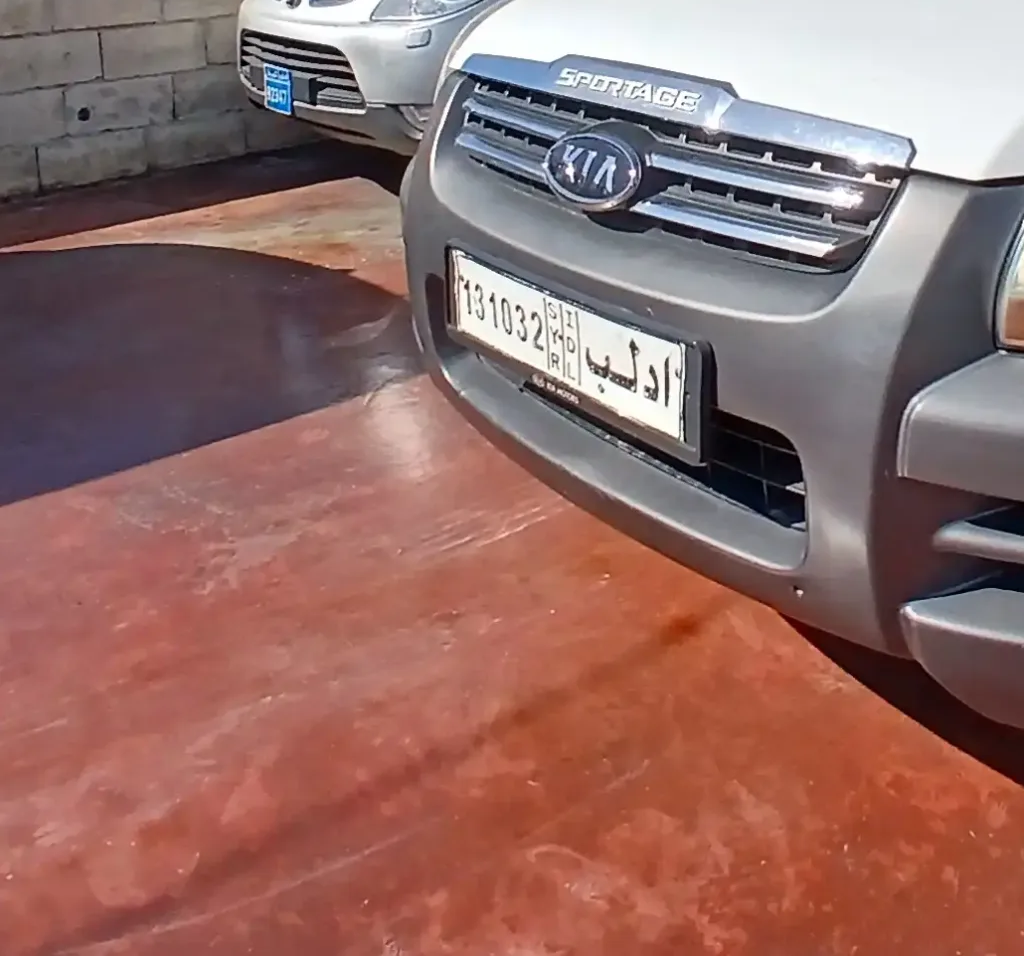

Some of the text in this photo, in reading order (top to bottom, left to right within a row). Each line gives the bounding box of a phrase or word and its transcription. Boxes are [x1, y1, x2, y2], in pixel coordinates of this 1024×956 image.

[555, 67, 702, 114] SPORTAGE
[562, 144, 617, 193] KIA
[463, 279, 544, 352] 131032
[585, 338, 671, 407] ادلب
